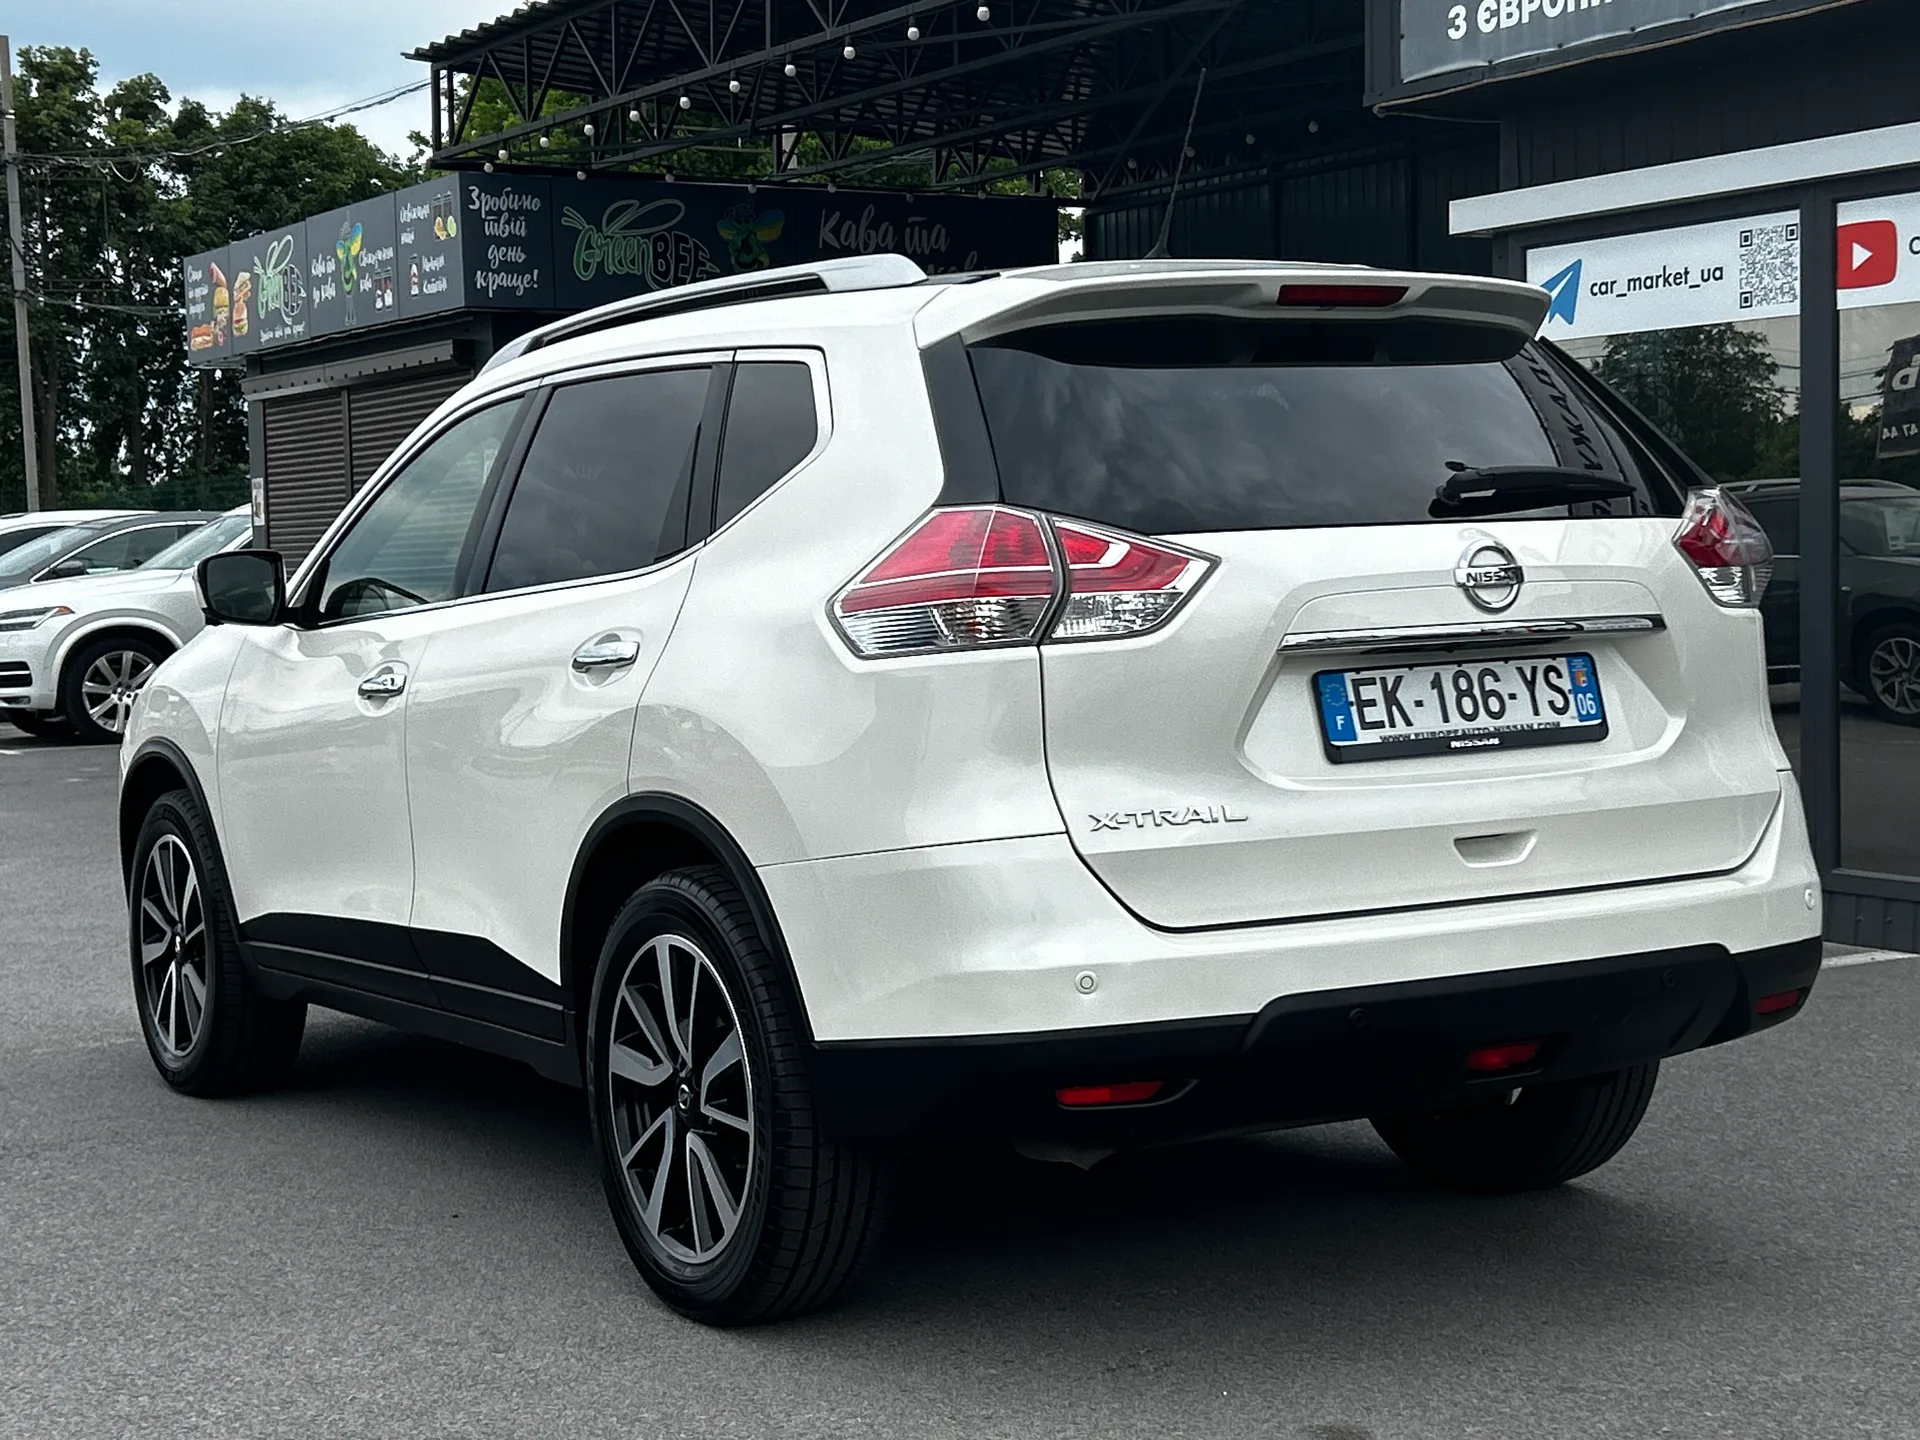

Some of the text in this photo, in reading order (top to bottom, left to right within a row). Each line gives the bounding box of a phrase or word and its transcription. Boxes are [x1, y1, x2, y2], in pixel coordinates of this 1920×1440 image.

[1476, 0, 1613, 33] ЄВРО
[819, 203, 897, 254] Кава
[487, 246, 527, 270] день
[474, 268, 539, 299] краще!
[1589, 263, 1724, 299] car_market_ua
[1351, 664, 1570, 731] EK-186-YS
[1577, 692, 1597, 715] 06
[1336, 714, 1345, 732] F
[1450, 737, 1500, 749] NISSAN
[1088, 804, 1249, 832] X-TRAIL
